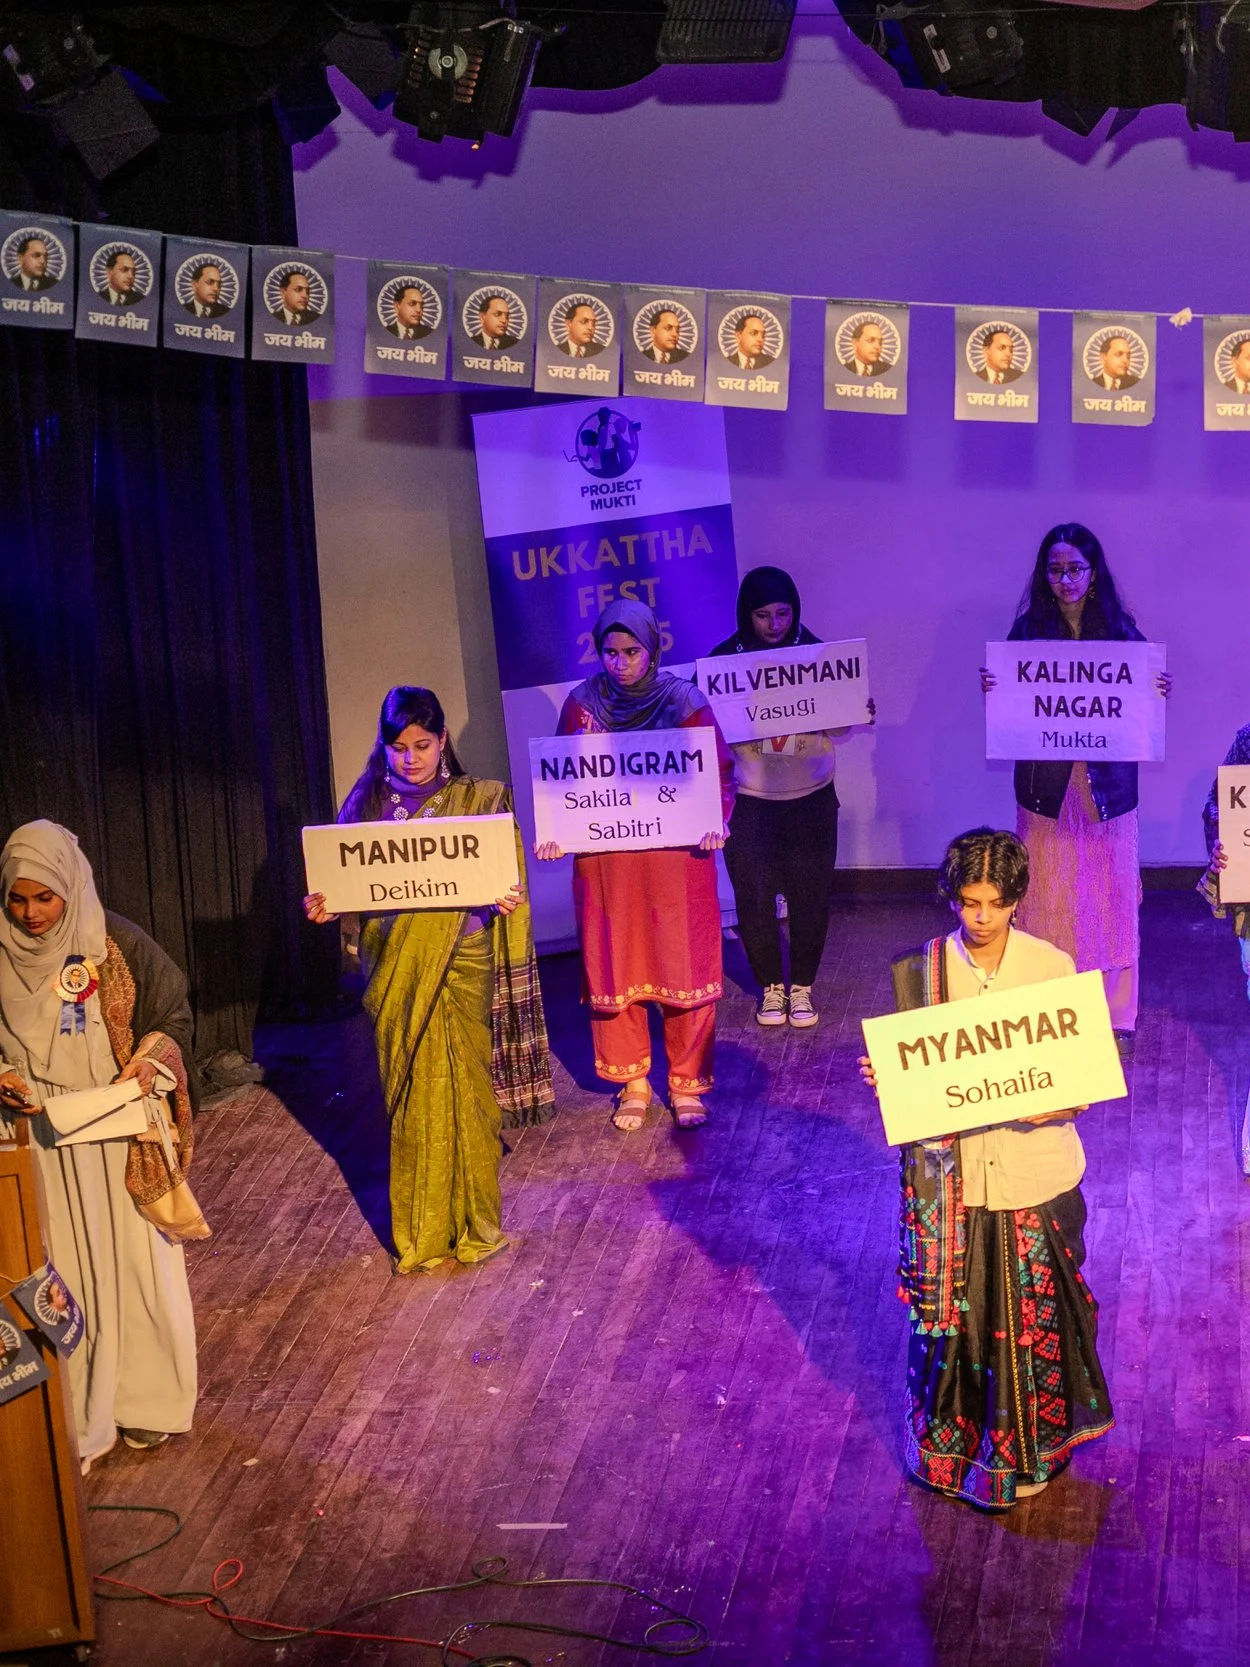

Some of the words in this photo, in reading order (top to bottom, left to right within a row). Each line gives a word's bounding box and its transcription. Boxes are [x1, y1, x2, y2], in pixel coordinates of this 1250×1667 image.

[2, 298, 30, 312] जय
[32, 296, 64, 314] भीम
[88, 312, 117, 326] जय
[118, 312, 149, 331] भीम
[174, 324, 202, 338] जय
[205, 324, 235, 343] भीम
[264, 334, 293, 347] जय
[295, 331, 326, 349] भीम
[377, 347, 405, 361] जय
[407, 346, 438, 364] भीम
[463, 357, 492, 370] जय
[494, 356, 525, 373] भीम
[548, 365, 577, 379] जय
[579, 364, 610, 382] भीम
[634, 371, 663, 384] जय
[664, 369, 696, 387] भीम
[718, 377, 747, 391] जय
[748, 375, 780, 393] भीम
[835, 384, 864, 397] जय
[866, 382, 898, 400] भीम
[967, 393, 996, 406] जय
[998, 389, 1029, 407] भीम
[1083, 399, 1113, 411] जय
[1114, 395, 1146, 413] भीम
[1216, 404, 1245, 416] जय
[580, 479, 642, 498] PROJECT
[590, 495, 636, 511] MUKTI
[512, 524, 713, 581] UKKATTHA
[576, 621, 674, 664] 25
[706, 657, 861, 696] KILVENMANI
[1017, 660, 1133, 684] KALINGA
[744, 697, 817, 724] Vasugi
[1034, 695, 1122, 718] NAGAR
[1042, 731, 1108, 748] Mukta
[540, 749, 704, 782] NANDIGRAM
[564, 788, 632, 810] Sakila
[657, 785, 677, 803] &
[588, 816, 662, 841] Sabitri
[339, 835, 480, 867] MANIPUR
[369, 878, 459, 902] Deikim
[897, 1007, 1080, 1071] MYANMAR
[945, 1067, 1055, 1109] Sohaifa
[11, 1361, 39, 1381] भीम
